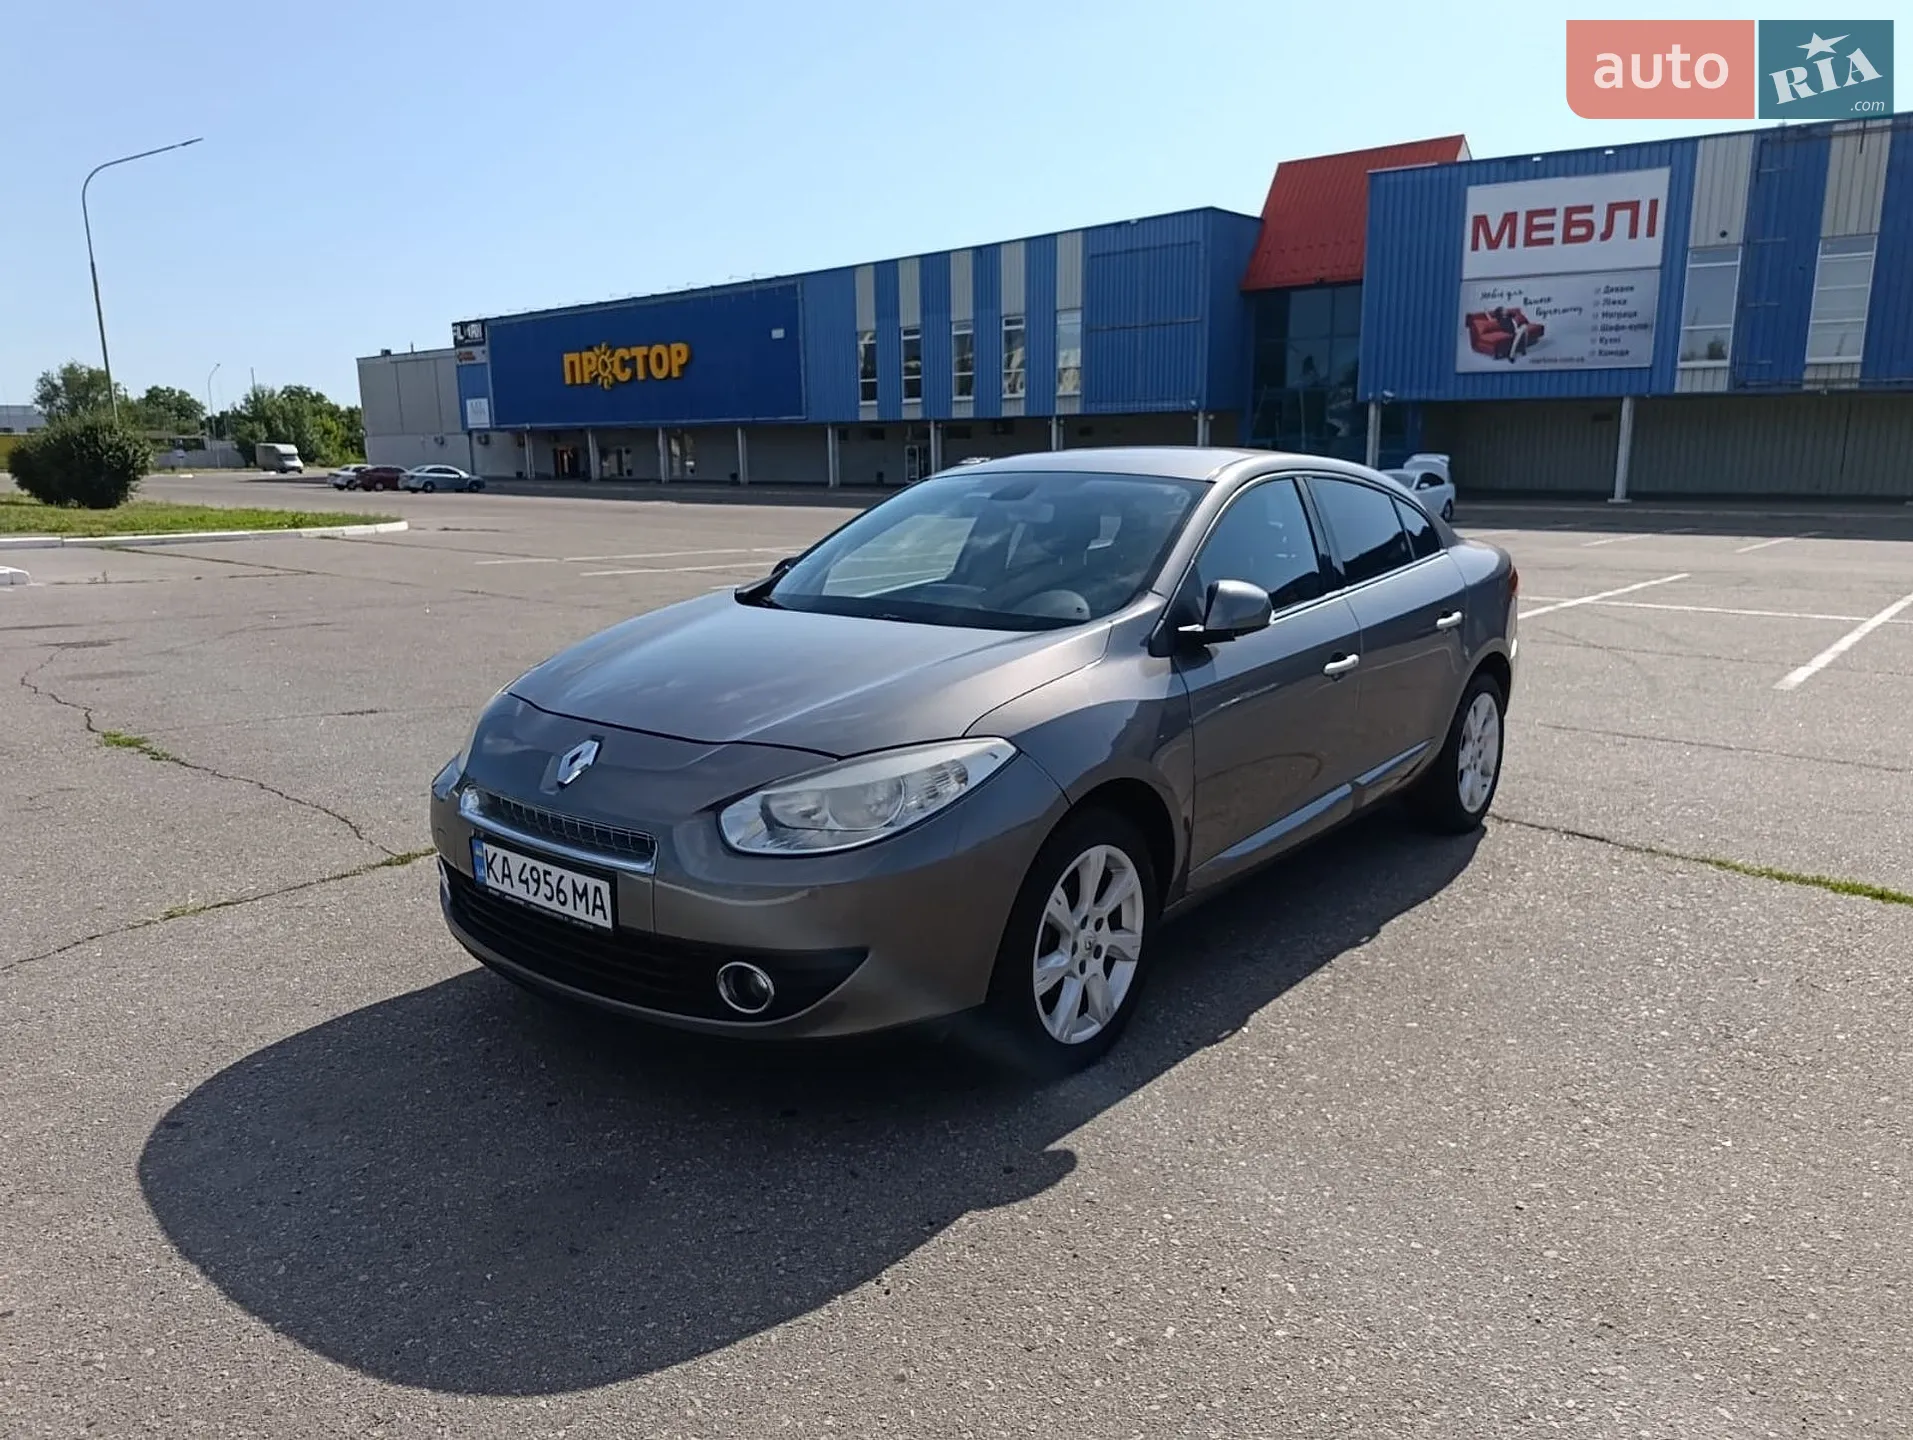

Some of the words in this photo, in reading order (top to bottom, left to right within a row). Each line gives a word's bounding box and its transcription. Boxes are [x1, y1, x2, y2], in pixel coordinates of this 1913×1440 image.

[1470, 198, 1659, 251] МЕБЛІ
[563, 342, 690, 390] ПРОСТОР
[485, 849, 514, 889] KA
[518, 862, 567, 907] 4956
[572, 878, 607, 921] MA
